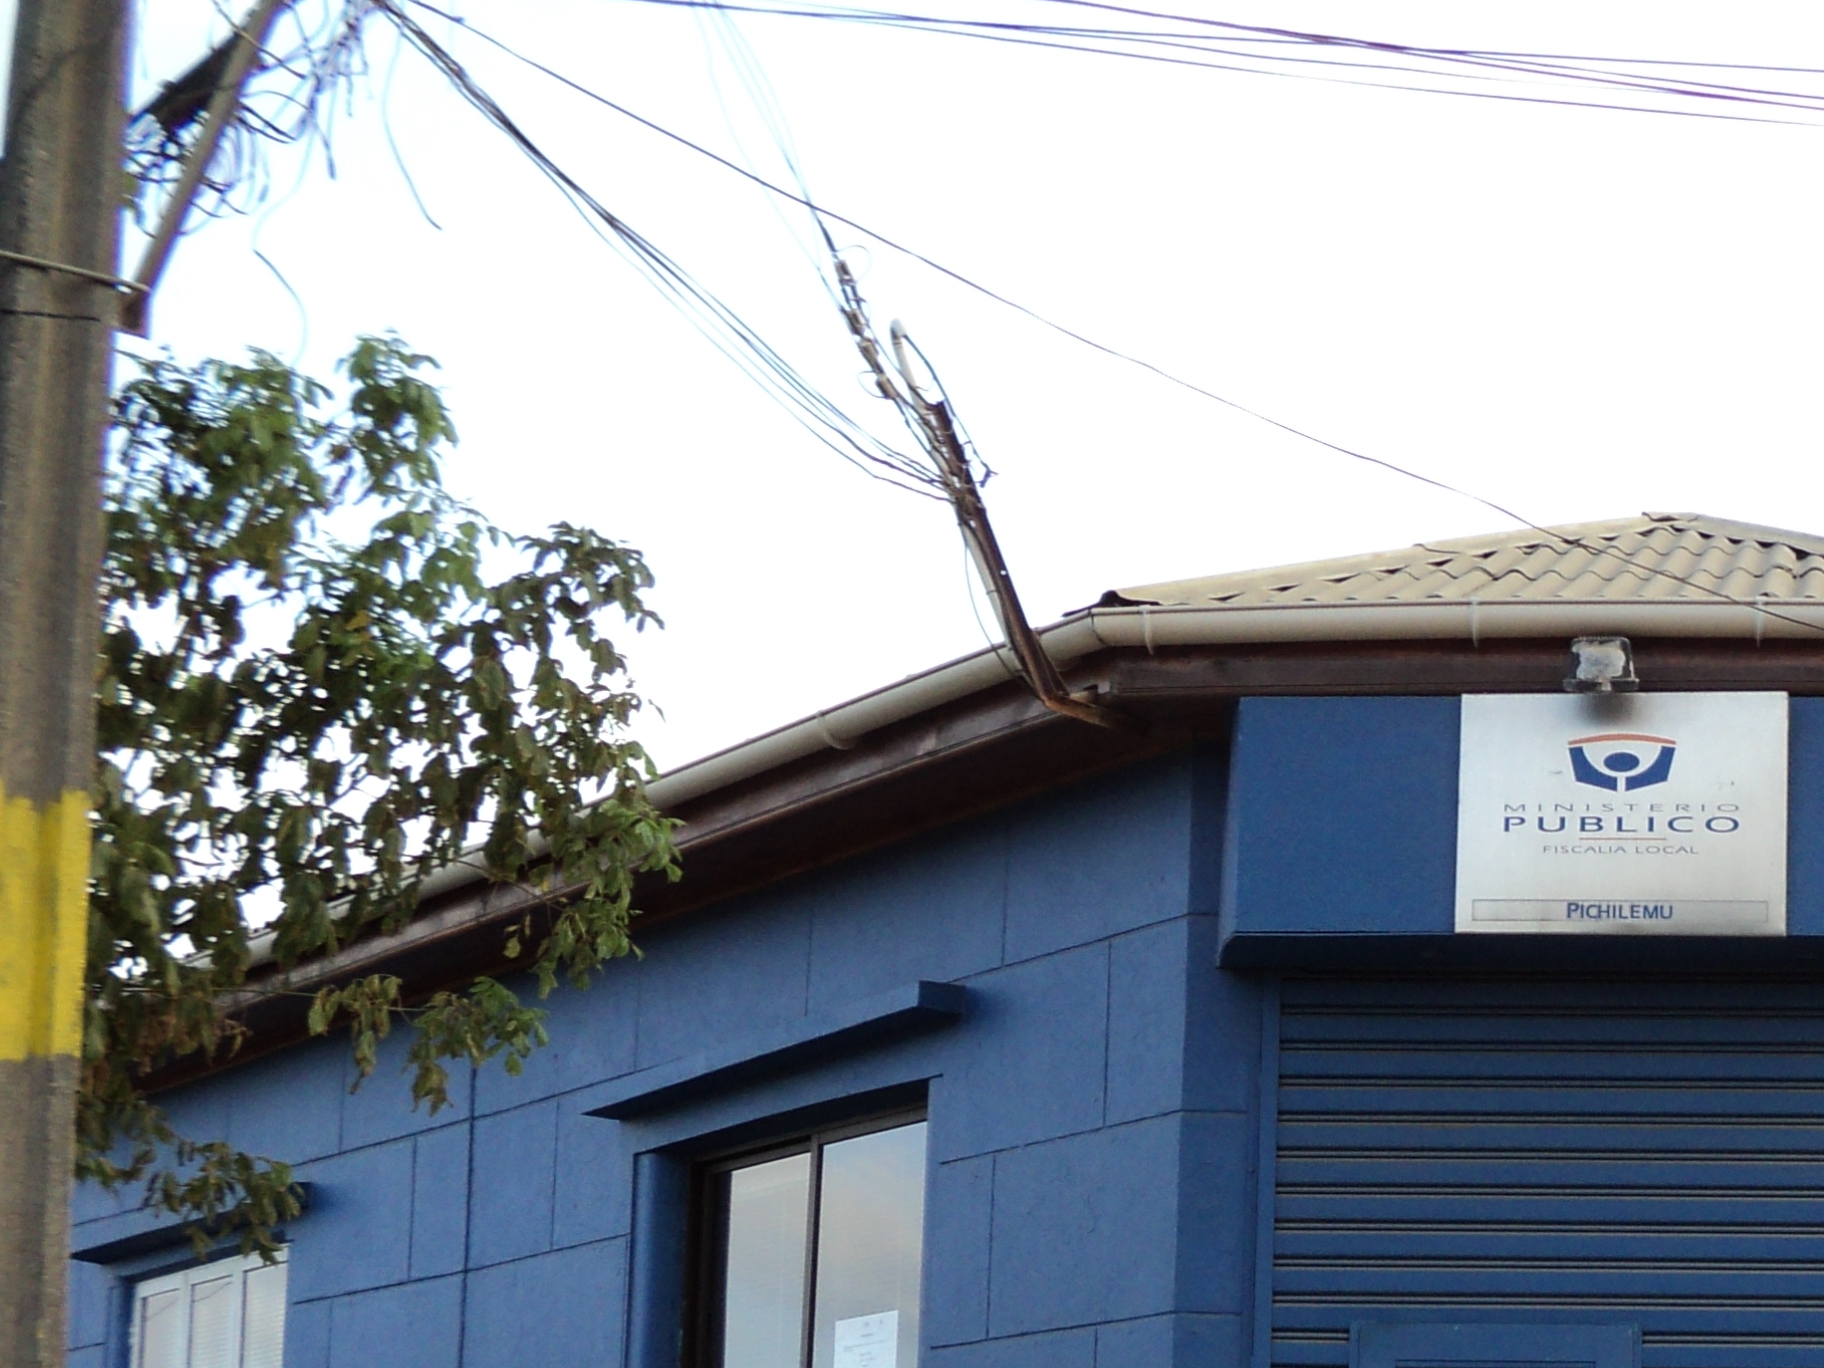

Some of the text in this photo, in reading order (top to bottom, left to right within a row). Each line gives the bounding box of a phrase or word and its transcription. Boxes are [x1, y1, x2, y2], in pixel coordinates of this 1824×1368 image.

[1503, 803, 1740, 812] MINISTERIO
[1503, 816, 1740, 833] PUBLICO
[1542, 845, 1699, 854] FISCALIA LOCAL
[1565, 901, 1674, 920] PICHILEMU
